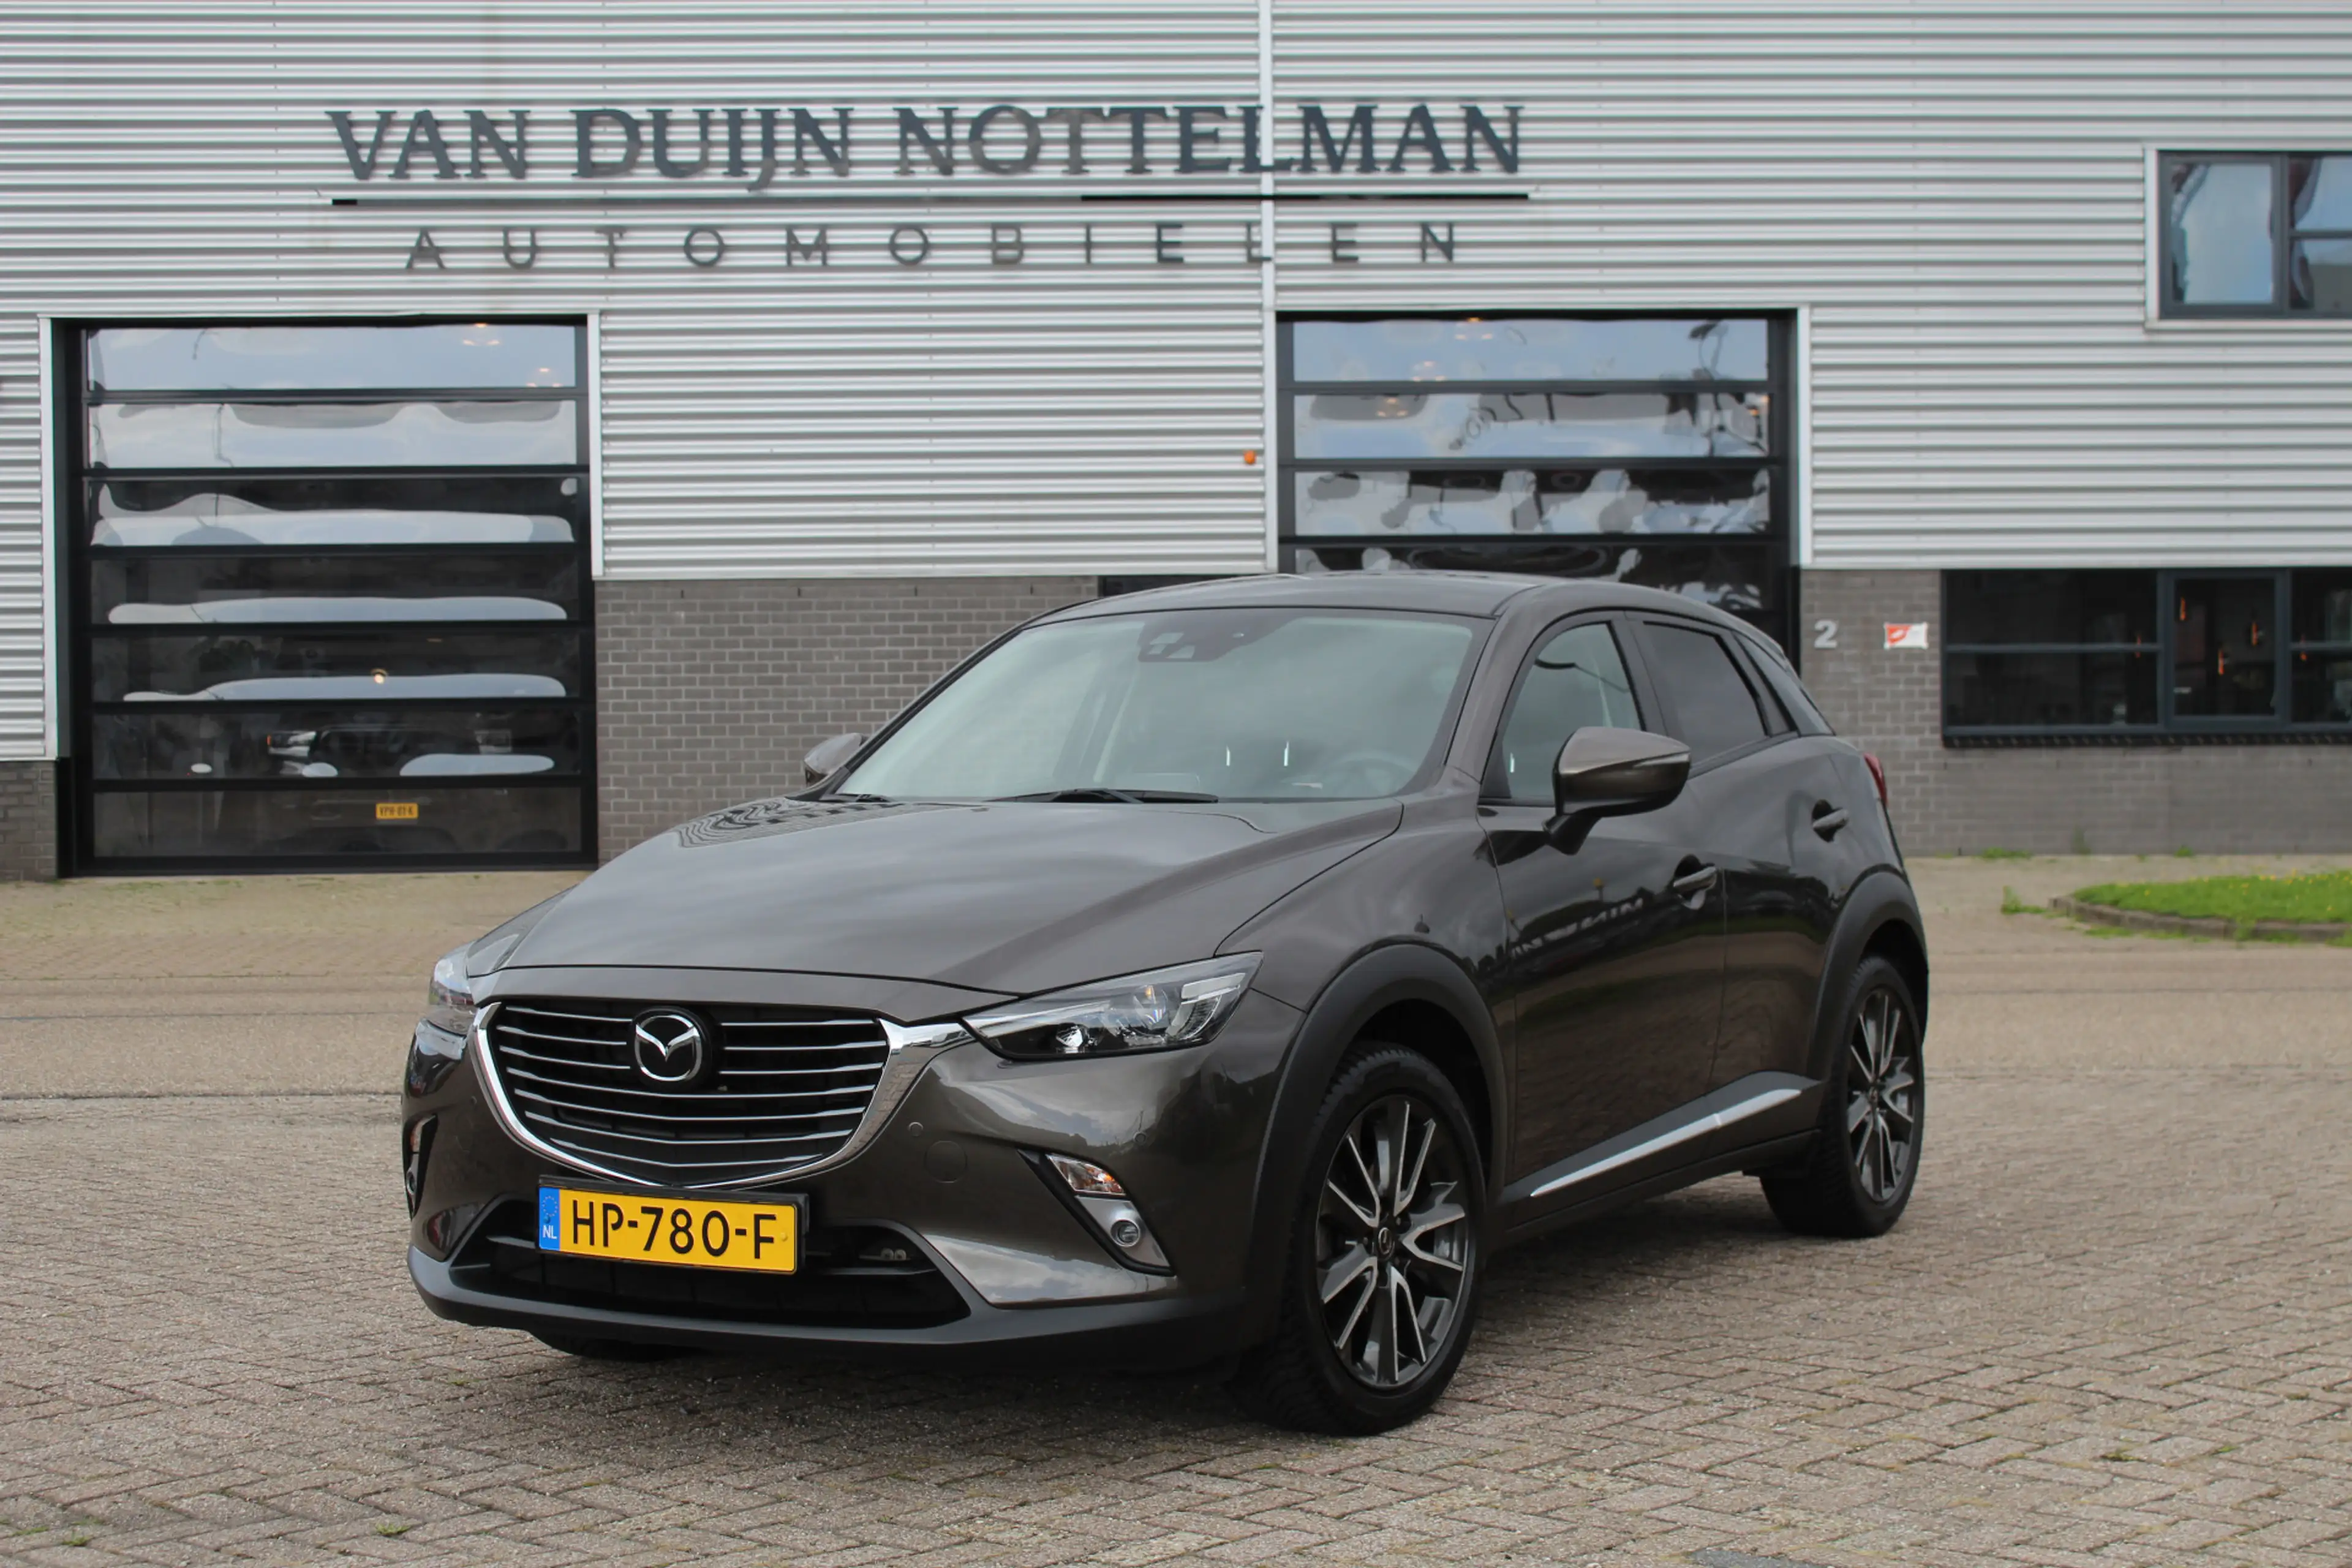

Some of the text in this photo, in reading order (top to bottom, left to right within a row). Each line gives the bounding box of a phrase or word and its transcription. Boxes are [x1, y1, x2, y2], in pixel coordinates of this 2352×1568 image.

[324, 103, 1525, 192] VAN DUIJN NOTTELMAN
[404, 222, 1455, 270] AUTOMOBIELEN
[1814, 619, 1838, 649] 2
[543, 1225, 557, 1240] NL
[572, 1199, 777, 1259] HP-780-F
